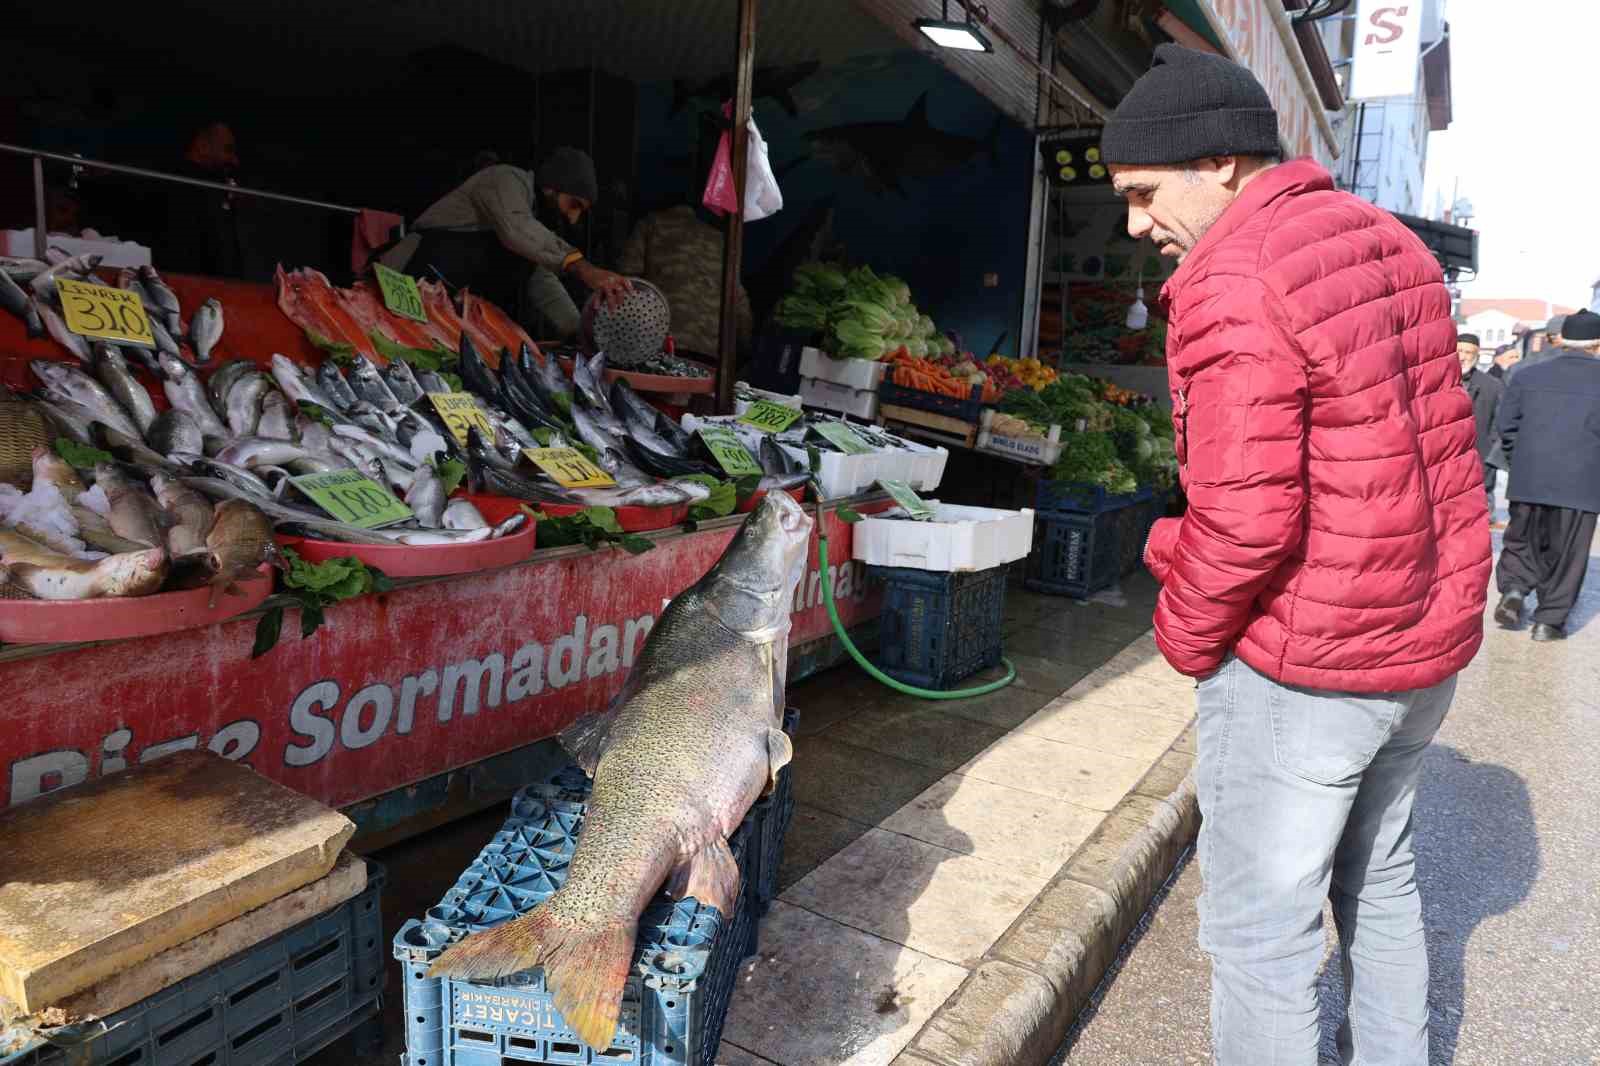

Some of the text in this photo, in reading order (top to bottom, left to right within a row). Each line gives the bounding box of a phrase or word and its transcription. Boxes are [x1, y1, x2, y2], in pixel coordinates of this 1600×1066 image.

[1364, 6, 1409, 46] S
[328, 486, 392, 521] 180
[9, 720, 260, 808] Bie
[282, 613, 655, 769] Sormadan
